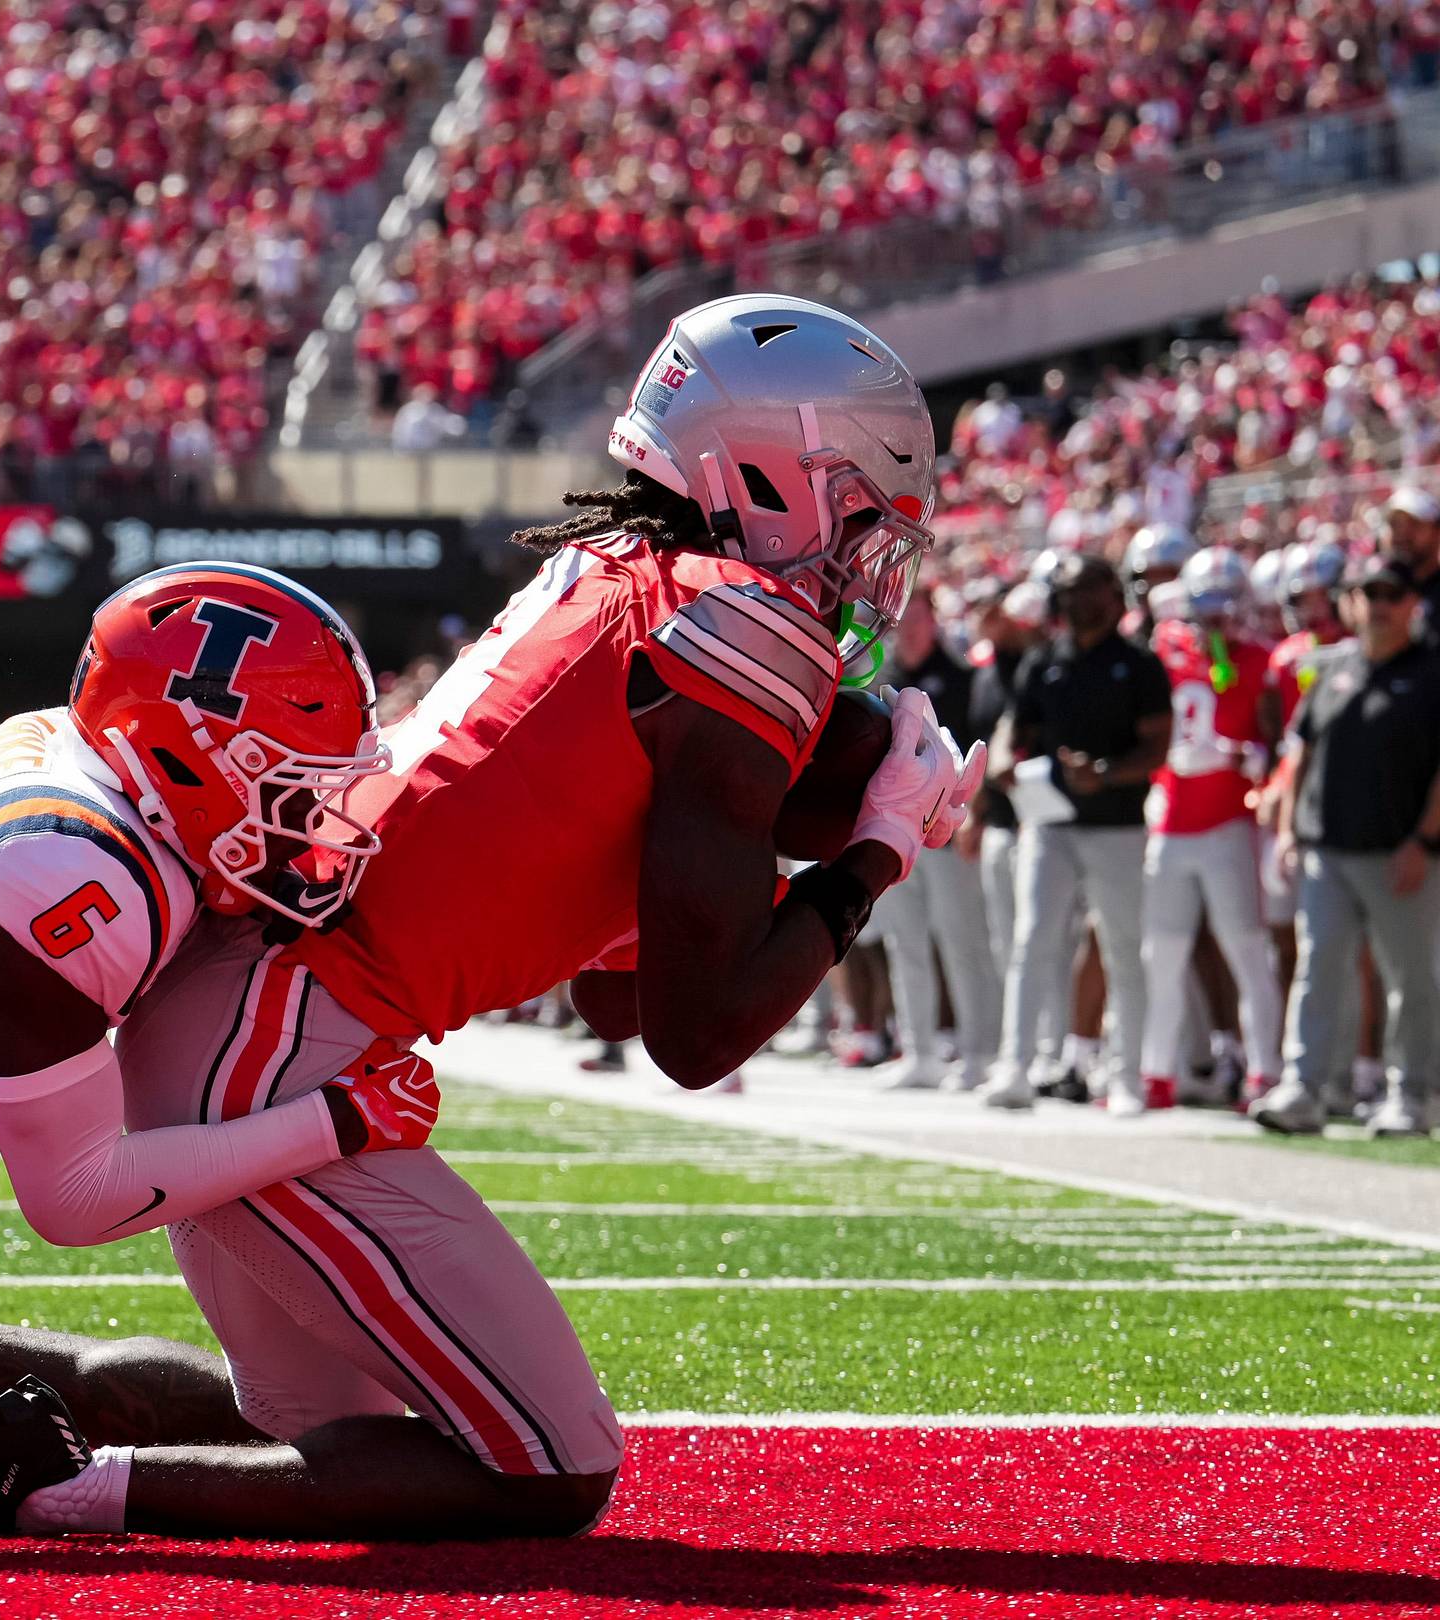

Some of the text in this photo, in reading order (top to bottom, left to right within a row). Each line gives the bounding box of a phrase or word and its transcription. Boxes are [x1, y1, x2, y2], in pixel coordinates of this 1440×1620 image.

[651, 361, 687, 391] BIG
[162, 597, 280, 726] I
[30, 880, 122, 959] 6
[0, 1463, 20, 1496] VAPOR
